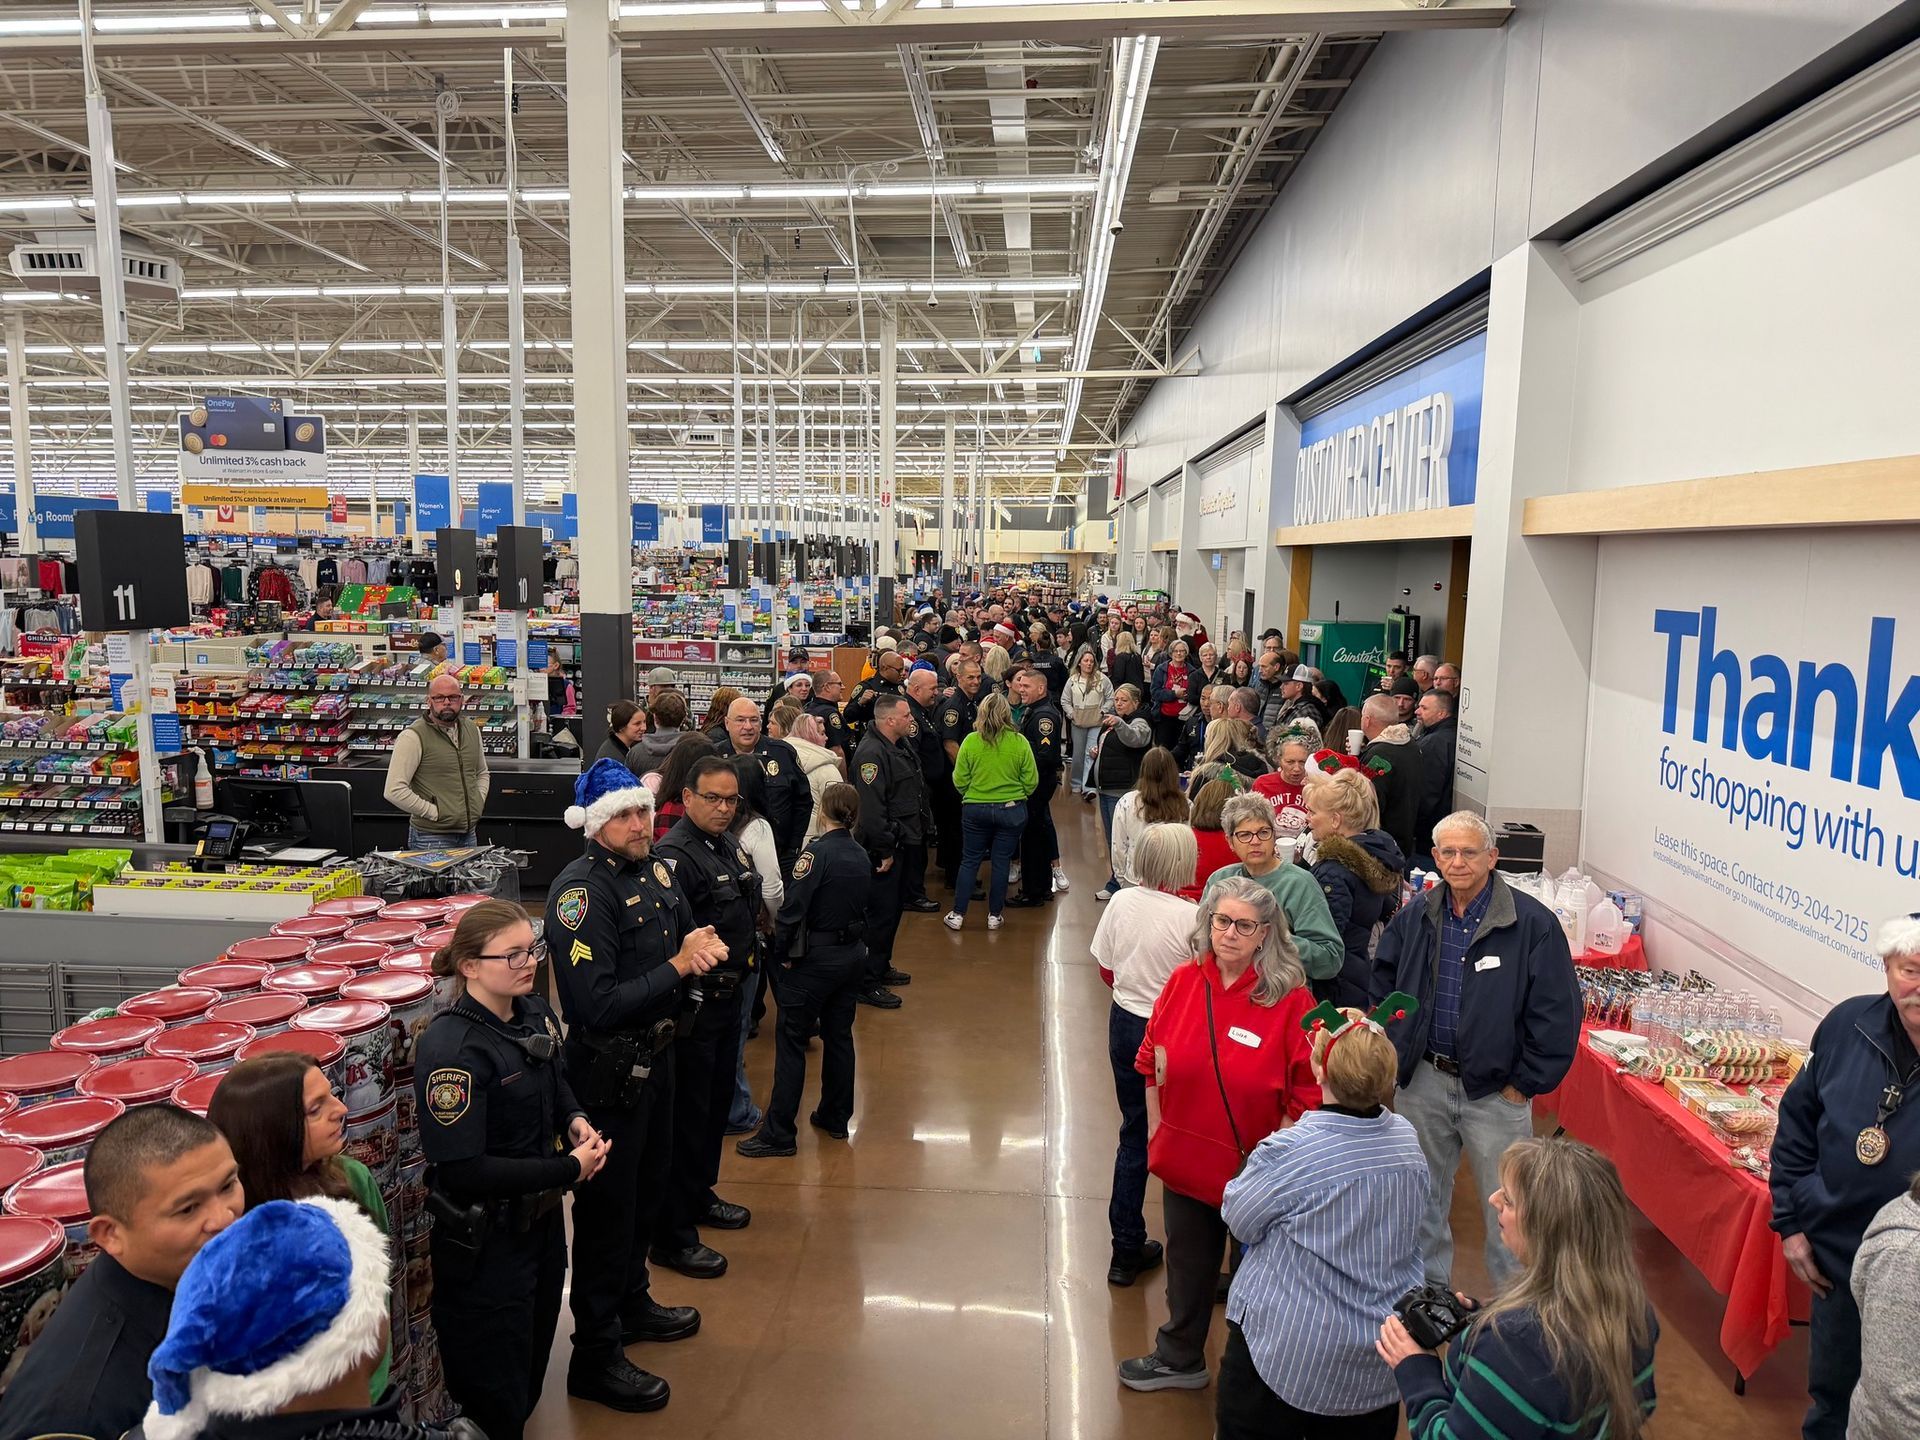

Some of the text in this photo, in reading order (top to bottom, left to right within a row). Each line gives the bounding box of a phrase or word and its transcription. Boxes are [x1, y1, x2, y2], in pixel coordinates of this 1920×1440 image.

[207, 400, 236, 408] OnePay
[199, 455, 307, 467] Unlimited 3% cash back
[1294, 392, 1453, 526] CUSTOMER CENTER
[418, 502, 444, 510] Women's
[46, 511, 75, 522] Rooms
[454, 568, 462, 591] 9
[518, 577, 528, 604] 10
[113, 584, 136, 621] 11
[1407, 619, 1415, 639] Phones
[650, 643, 683, 659] Marlboro
[1332, 647, 1379, 664] Coinstar
[1654, 606, 1920, 802] Thank
[1460, 720, 1473, 732] Returns
[1459, 731, 1482, 749] Replacements
[1458, 744, 1472, 757] Refunds
[1456, 766, 1473, 782] Questions
[1270, 792, 1292, 807] ON'T
[1659, 745, 1920, 880] for shopping with u
[1654, 825, 1869, 943] Lease this space. Contact 479-204-2125
[1732, 889, 1741, 901] go
[1741, 893, 1748, 905] to
[431, 1072, 467, 1084] SHERIFF
